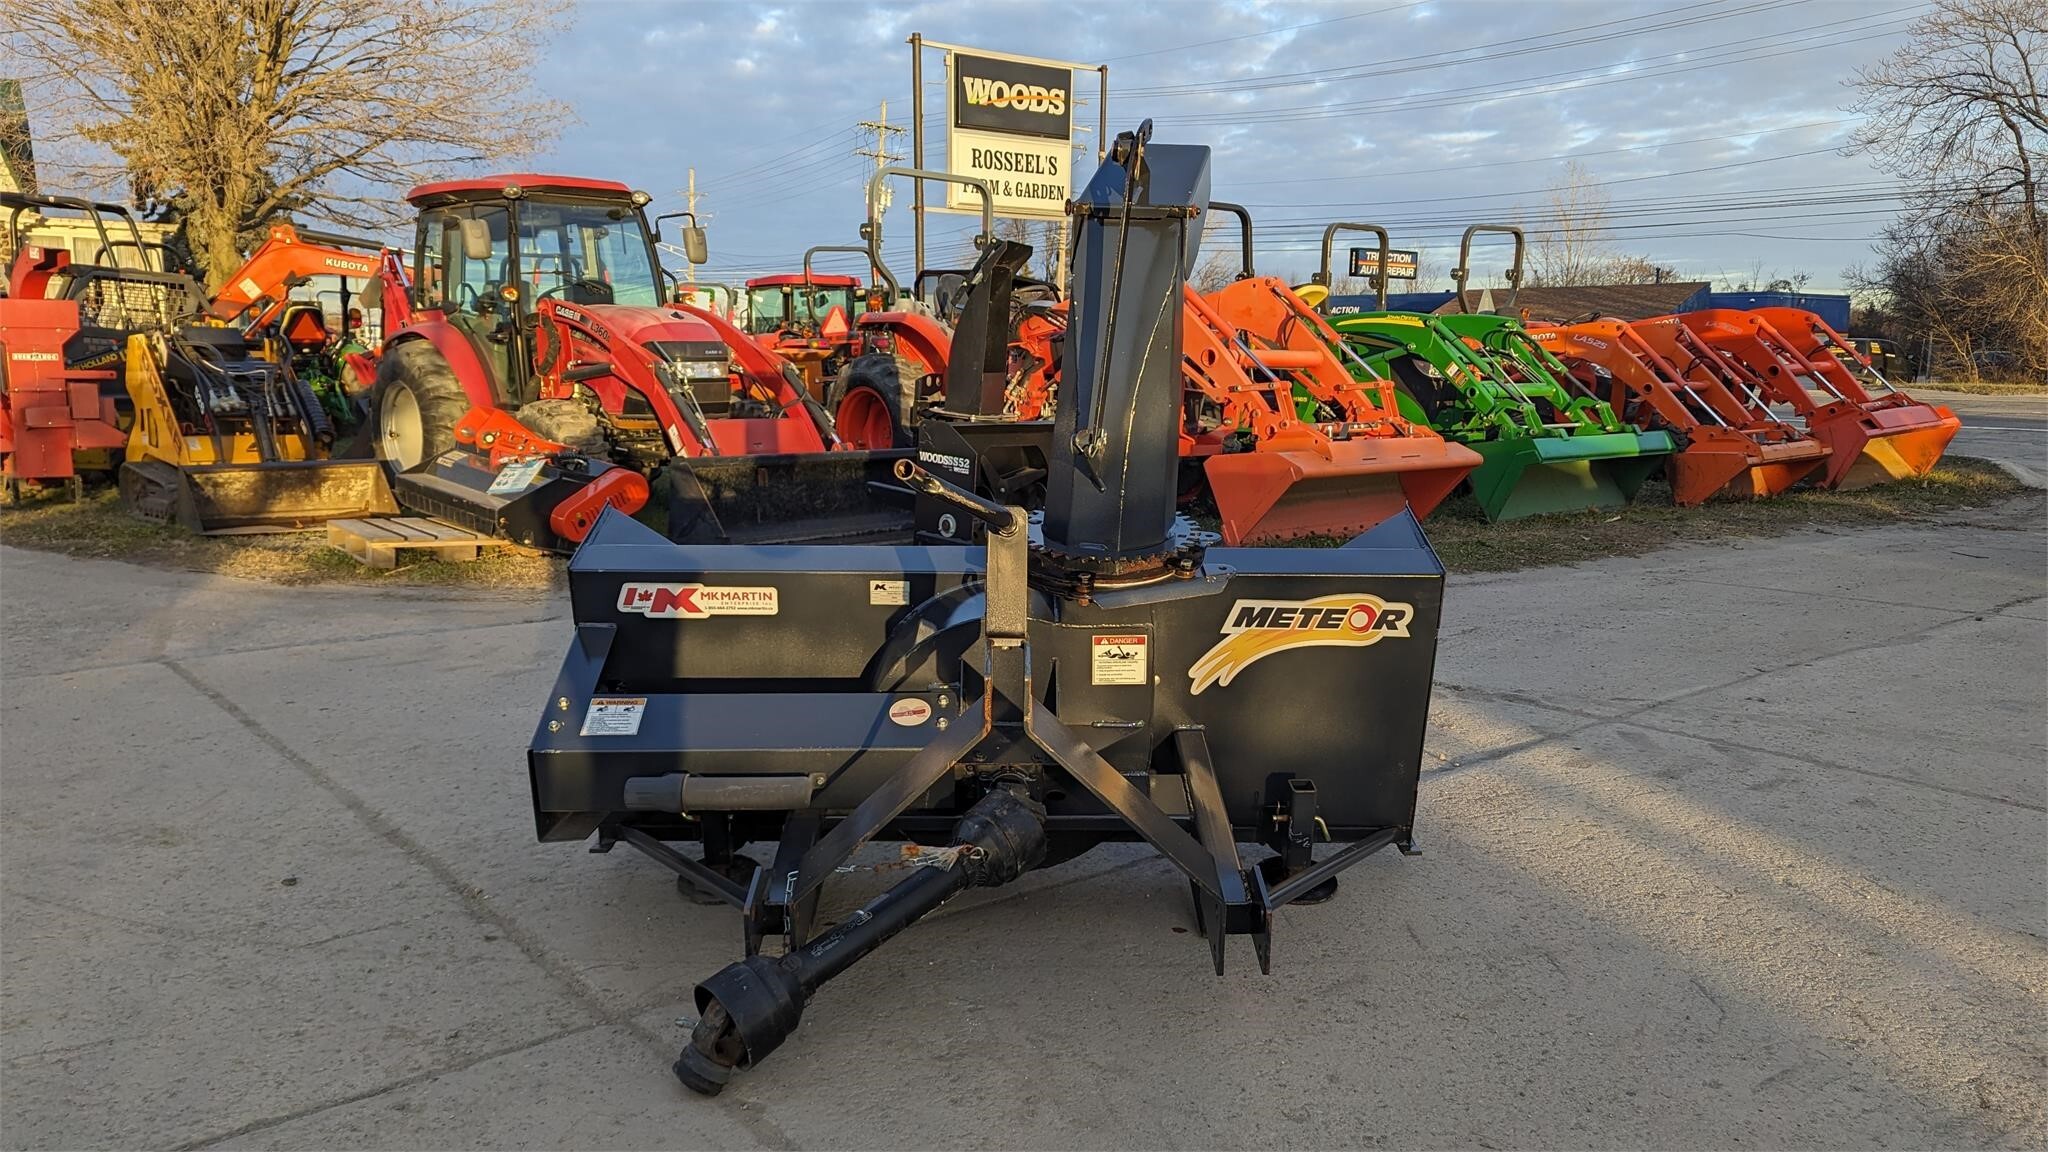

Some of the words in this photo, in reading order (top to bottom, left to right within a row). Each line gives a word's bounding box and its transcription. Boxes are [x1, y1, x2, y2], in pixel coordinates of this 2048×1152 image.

[962, 76, 1066, 116] WOODS
[971, 148, 1058, 176] ROSSEEL'S
[1003, 180, 1012, 197] &
[1015, 181, 1065, 201] GARDEN
[325, 257, 369, 272] KUBOTA
[1360, 265, 1379, 275] AUT
[1387, 266, 1415, 277] REPAIR
[555, 305, 574, 320] CASE
[1331, 306, 1360, 315] ACTION
[1573, 333, 1608, 350] LA525
[81, 353, 118, 369] HOLLAND
[1232, 604, 1406, 633] METEOR
[1109, 637, 1139, 645] DANGER
